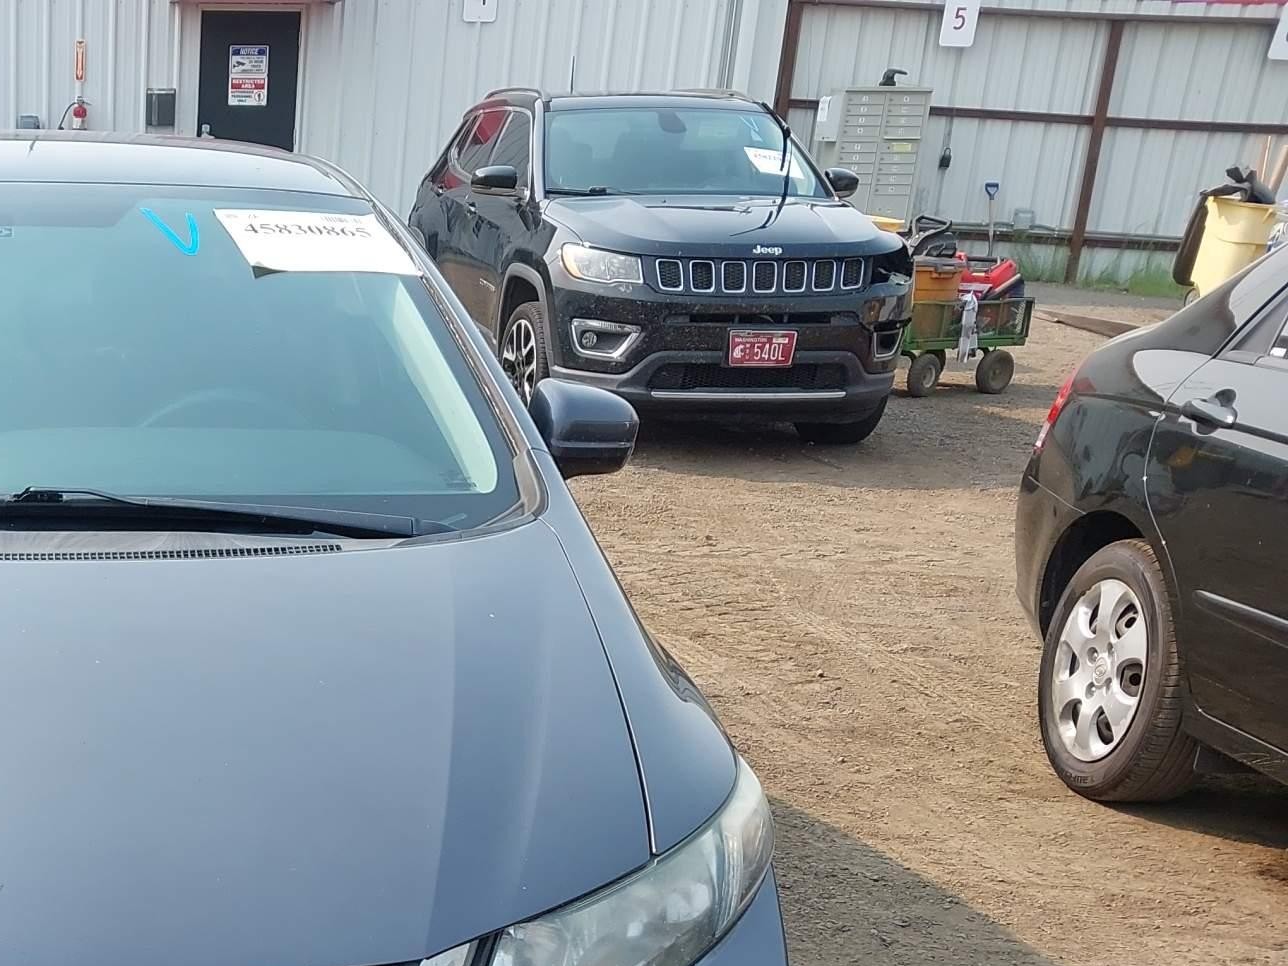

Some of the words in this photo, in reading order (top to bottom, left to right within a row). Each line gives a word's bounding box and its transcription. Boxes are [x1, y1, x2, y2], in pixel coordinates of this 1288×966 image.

[953, 7, 967, 30] 5
[244, 223, 372, 239] 45830865
[752, 244, 783, 256] Jeep
[753, 343, 786, 361] 540L
